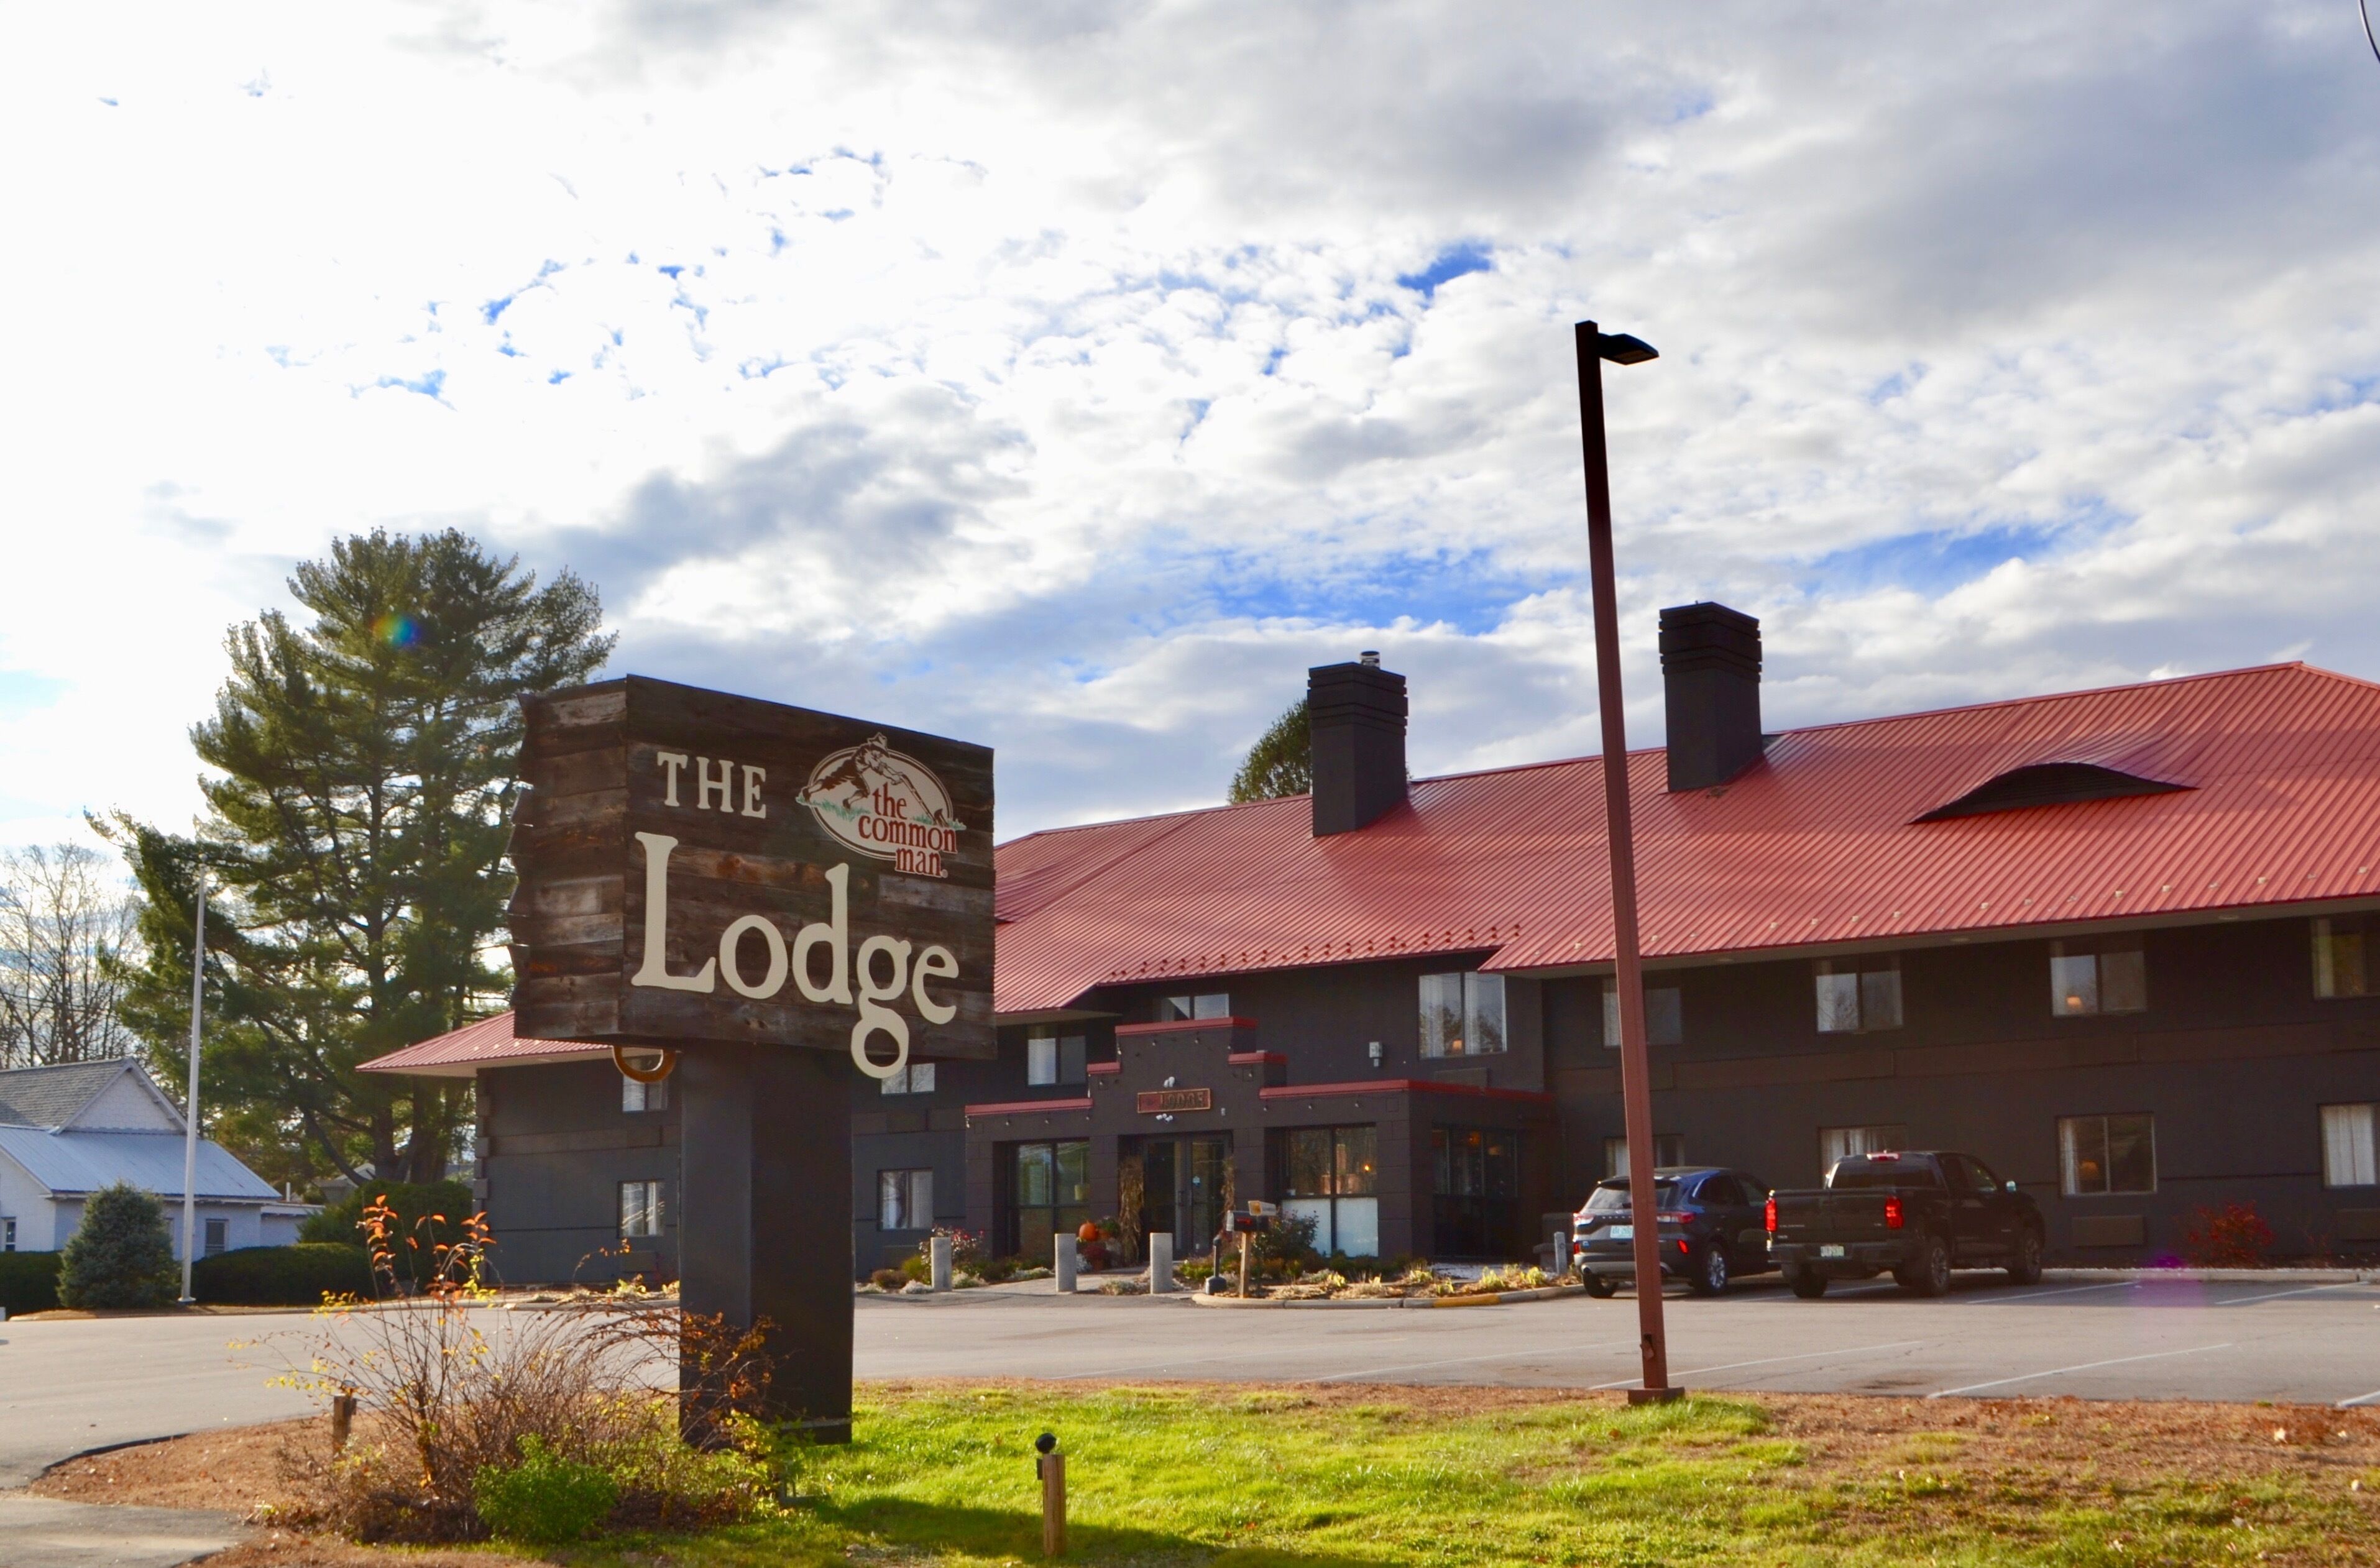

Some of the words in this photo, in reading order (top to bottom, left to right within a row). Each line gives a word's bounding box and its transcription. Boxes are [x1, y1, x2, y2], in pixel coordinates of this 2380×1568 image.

[657, 751, 766, 818] THE
[872, 782, 907, 820] the
[858, 815, 957, 853] common
[632, 831, 958, 1078] Lodge
